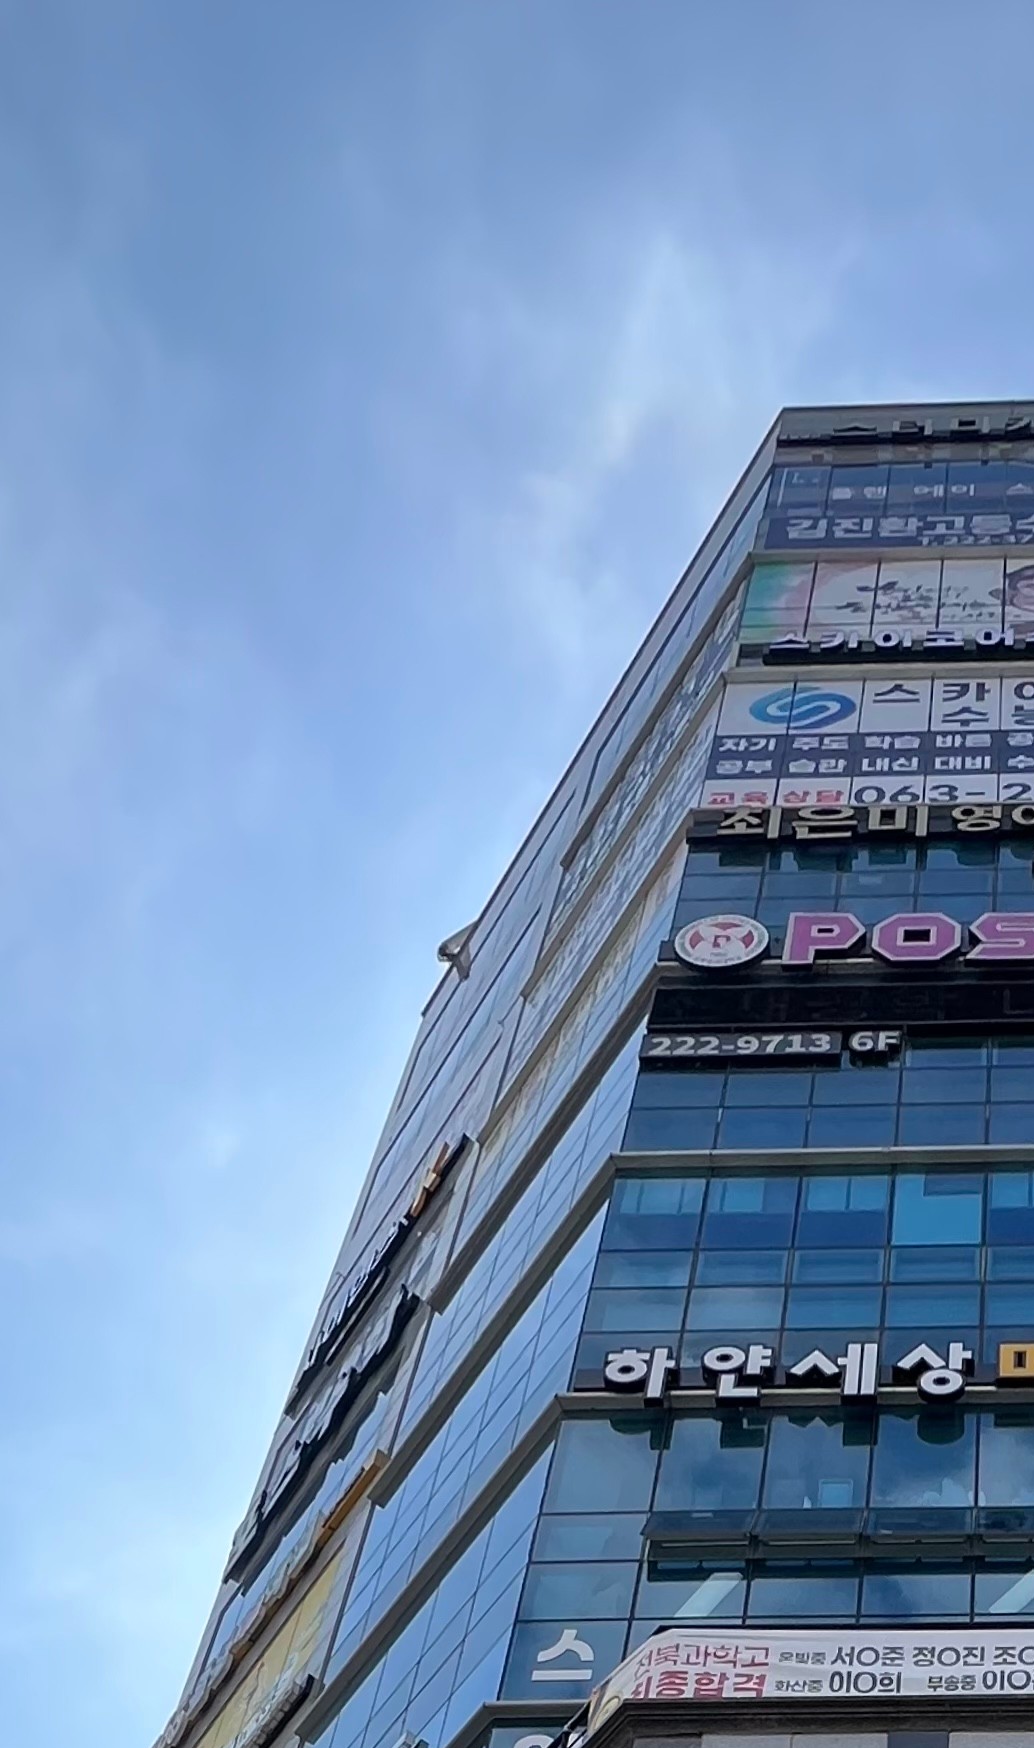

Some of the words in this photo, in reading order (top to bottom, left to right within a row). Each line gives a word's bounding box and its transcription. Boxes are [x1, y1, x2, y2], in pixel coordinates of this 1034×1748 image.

[914, 483, 975, 497] 에이
[716, 805, 927, 839] 최은미
[650, 1033, 832, 1056] 222-9713
[850, 1031, 902, 1053] 6F
[603, 1341, 974, 1399] 하얀세상
[927, 1675, 976, 1692] 부송중
